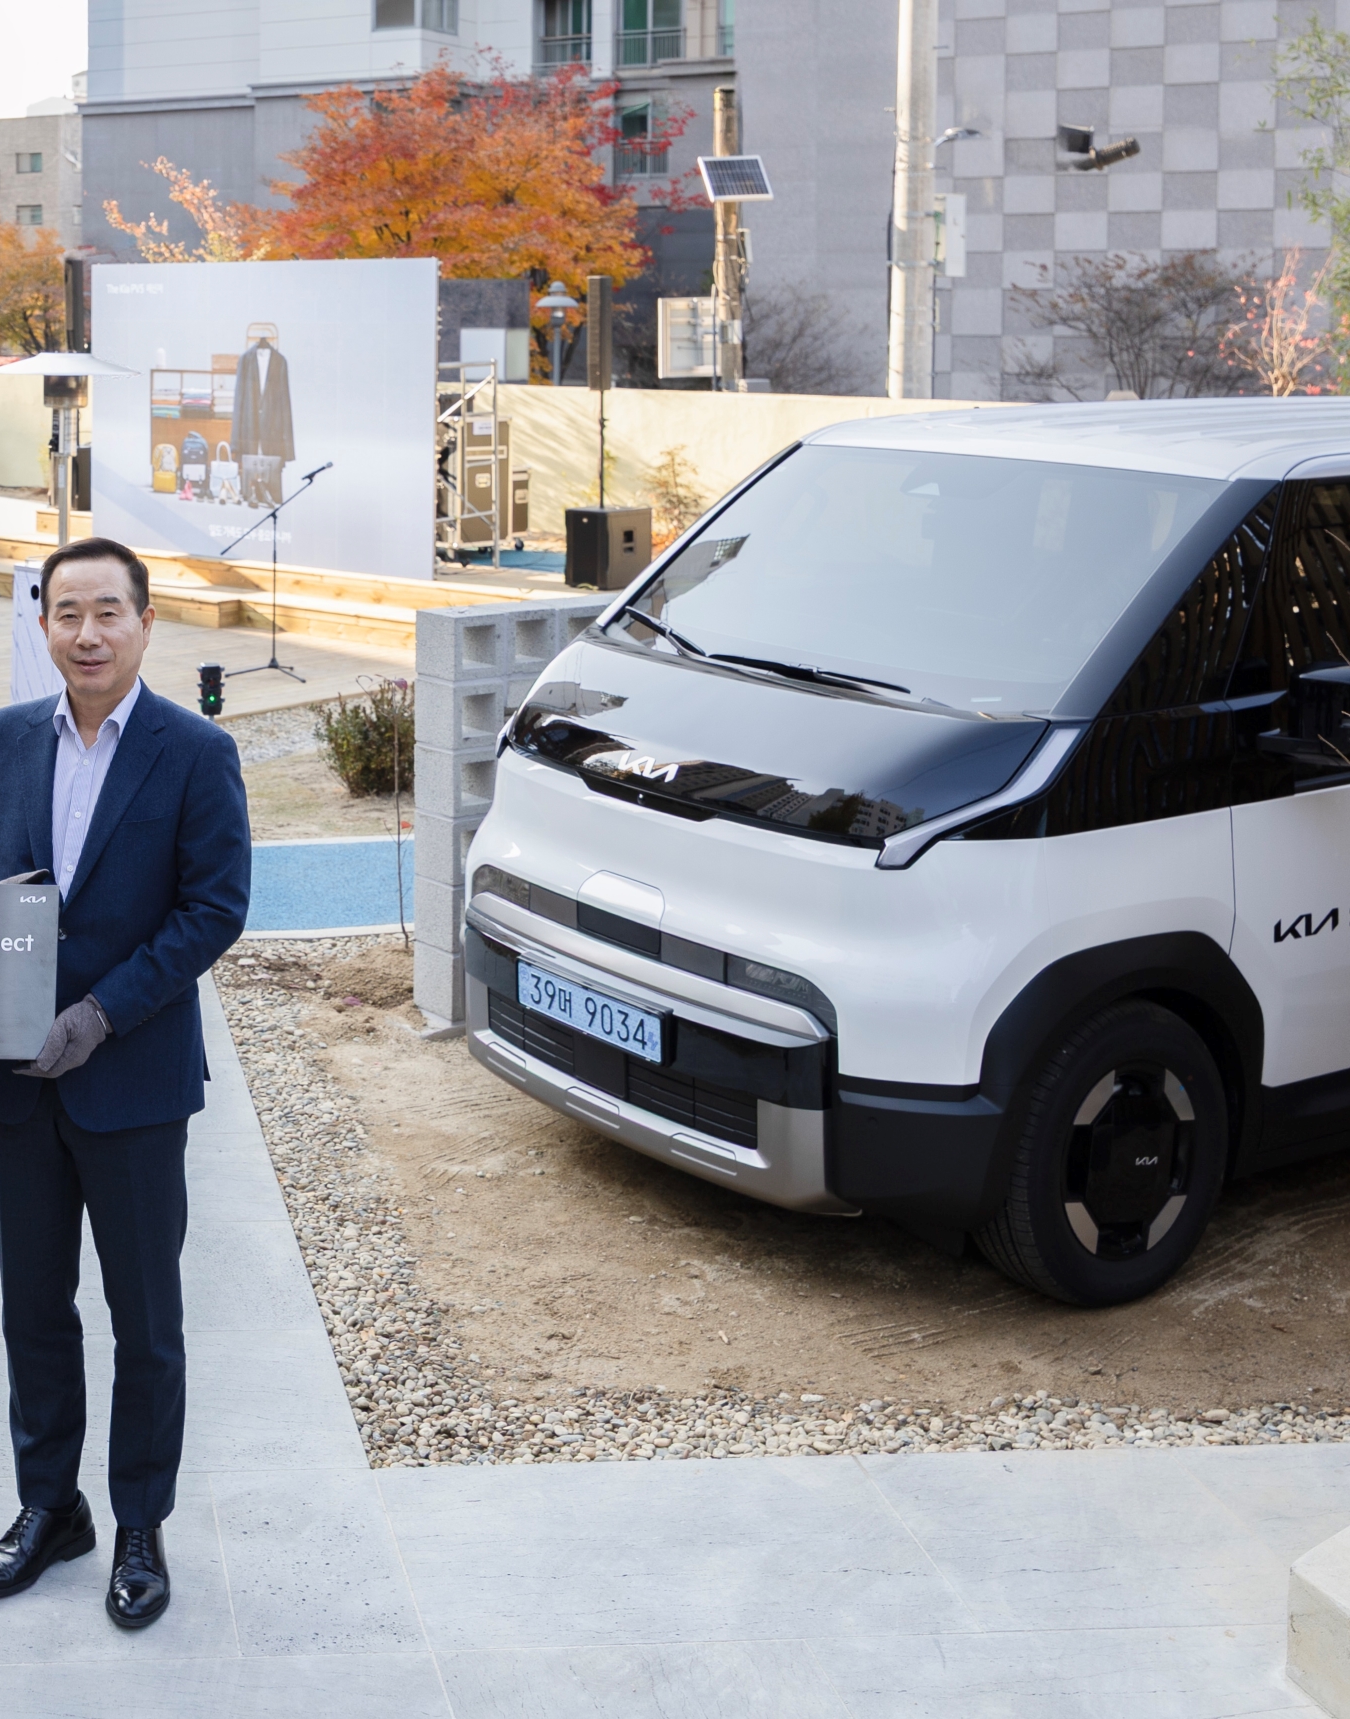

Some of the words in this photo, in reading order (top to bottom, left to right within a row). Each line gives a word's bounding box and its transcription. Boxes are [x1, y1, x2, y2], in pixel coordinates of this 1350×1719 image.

[617, 751, 679, 783] KIA
[20, 895, 47, 904] KIA
[1273, 907, 1339, 943] KIA
[530, 973, 572, 1019] 39머
[584, 996, 648, 1050] 9034
[1135, 1156, 1158, 1166] KIA
